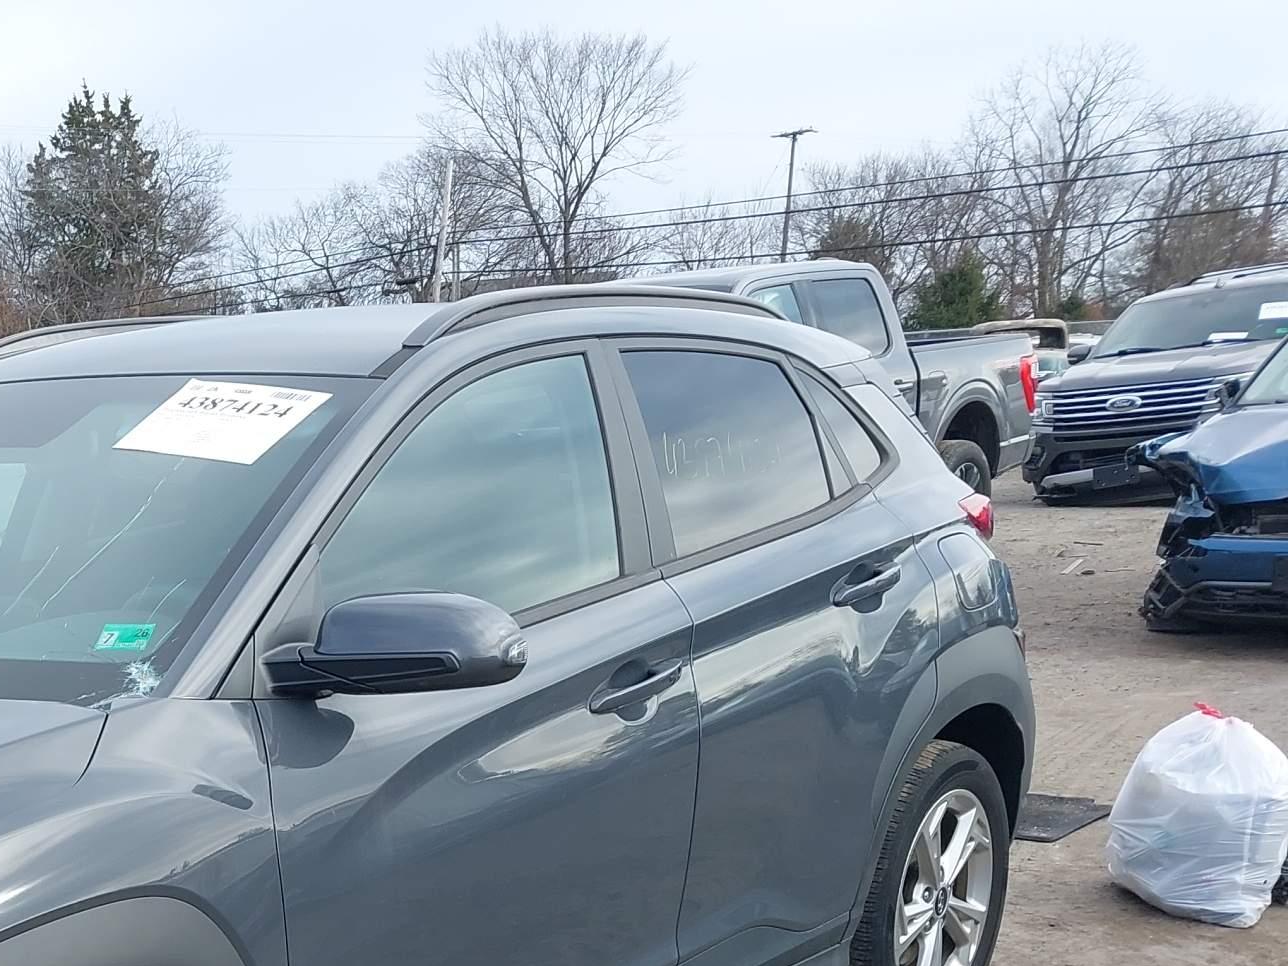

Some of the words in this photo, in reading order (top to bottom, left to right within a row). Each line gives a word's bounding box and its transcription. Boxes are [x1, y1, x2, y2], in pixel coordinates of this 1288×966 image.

[177, 395, 294, 418] 43874124
[103, 632, 115, 645] 7
[133, 628, 150, 638] 26
